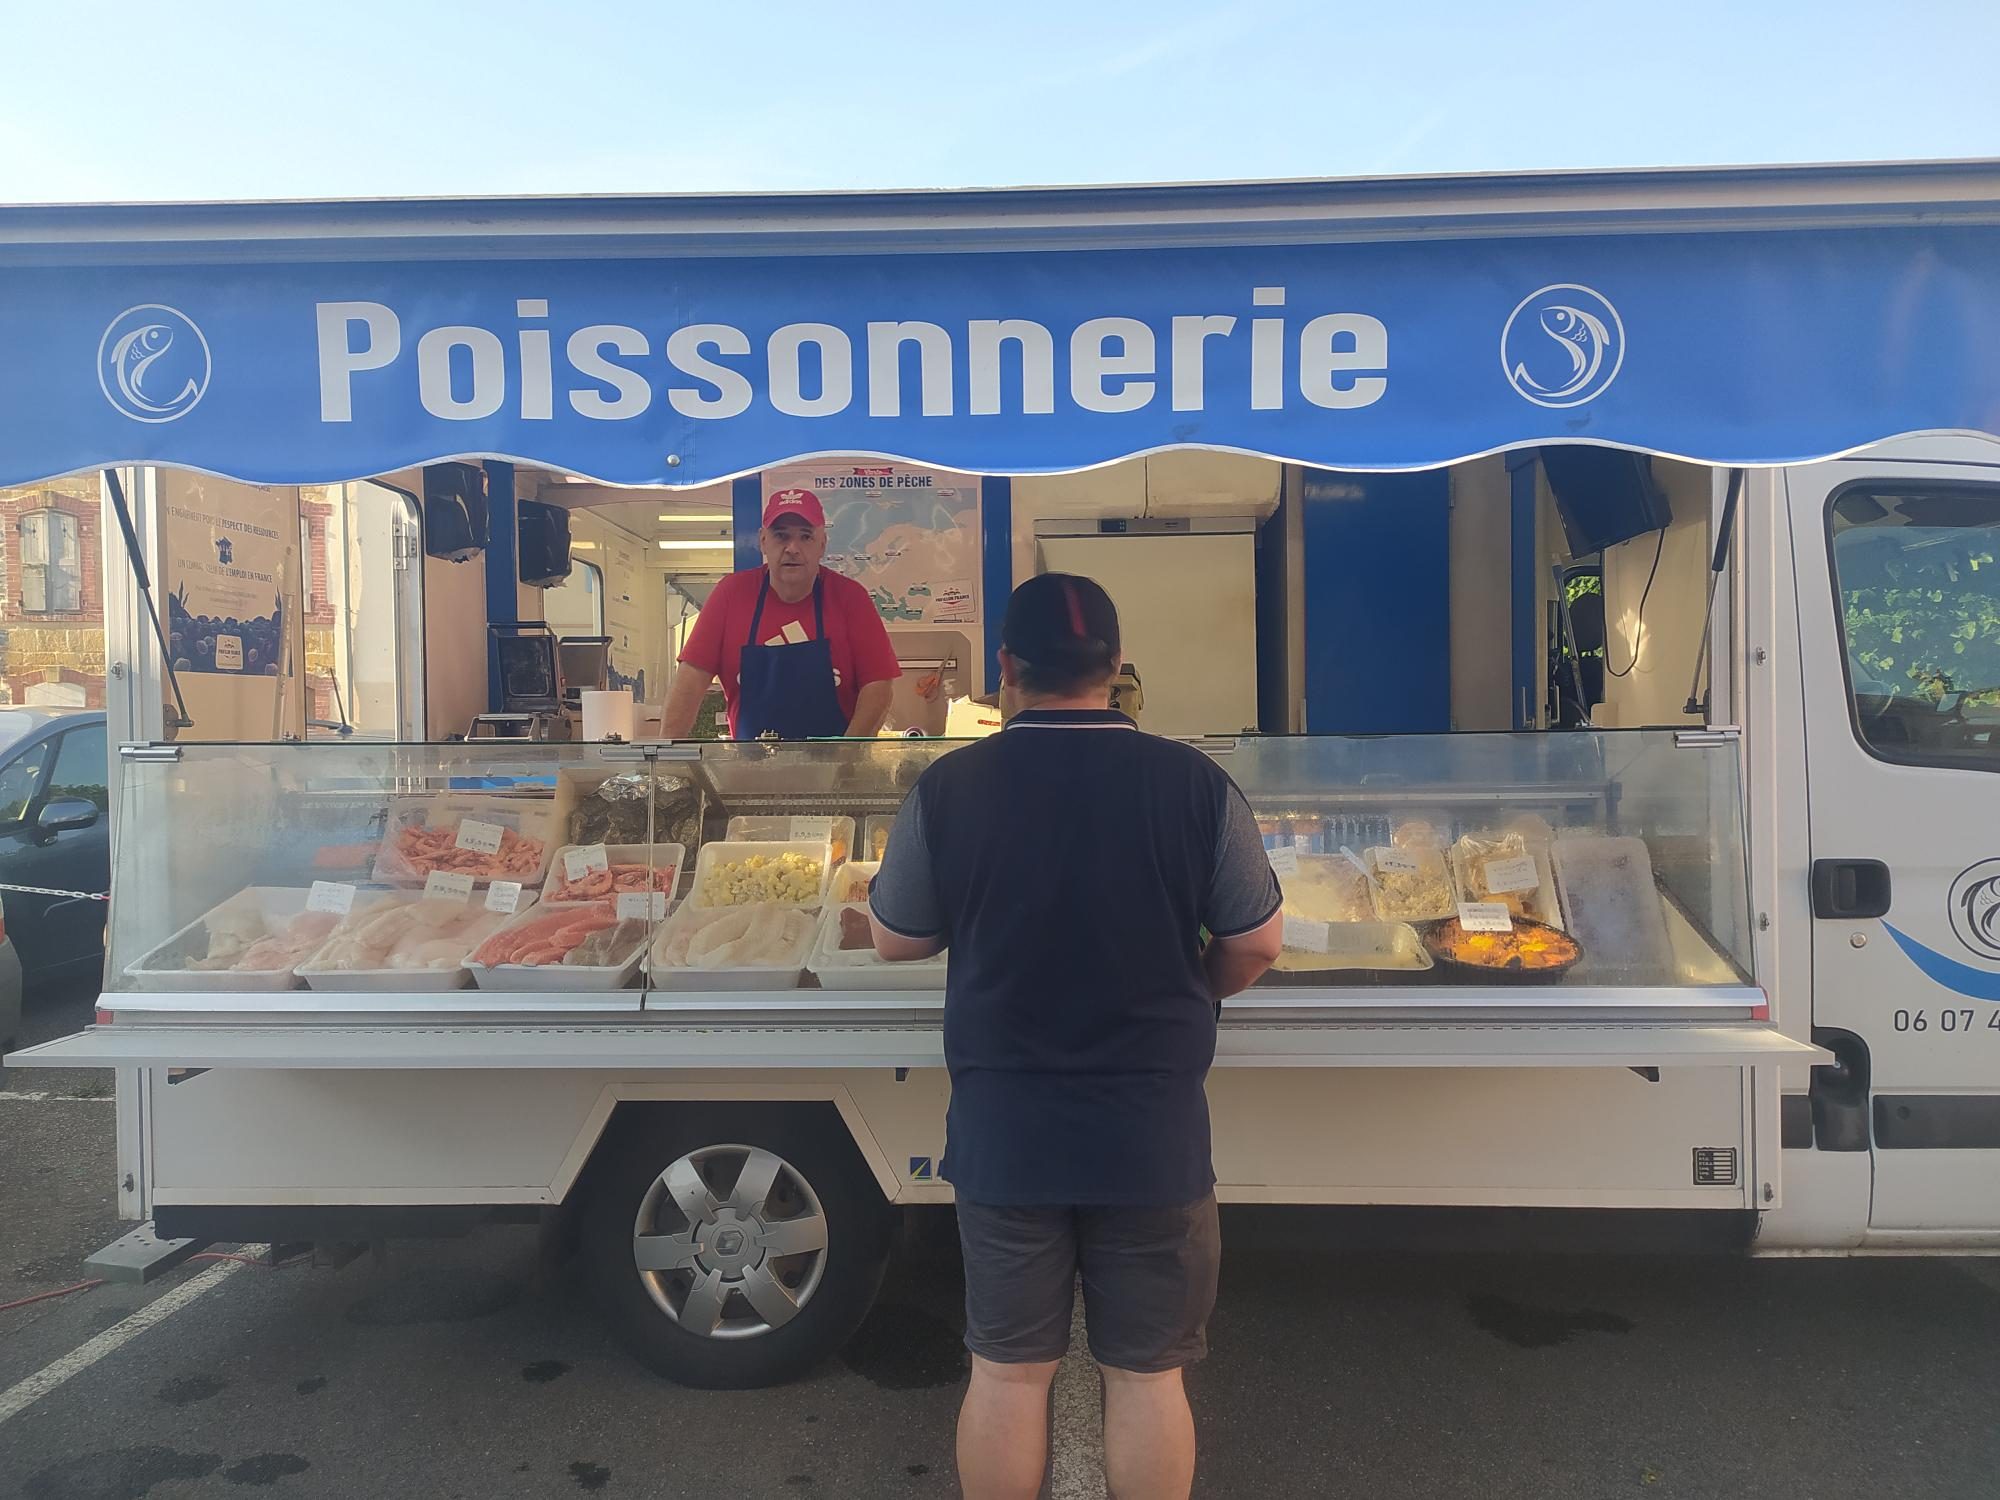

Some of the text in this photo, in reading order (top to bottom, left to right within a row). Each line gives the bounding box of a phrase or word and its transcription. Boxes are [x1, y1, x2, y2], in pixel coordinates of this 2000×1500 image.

[315, 286, 1389, 423] Poissonnerie
[815, 473, 933, 489] DES ZONES DE PÊCHE
[221, 518, 243, 532] RESPECT
[243, 523, 253, 534] DES
[247, 571, 255, 581] EN
[254, 573, 273, 584] FRANCE
[1894, 1009, 1928, 1032] 06
[1941, 1009, 1975, 1032] 07
